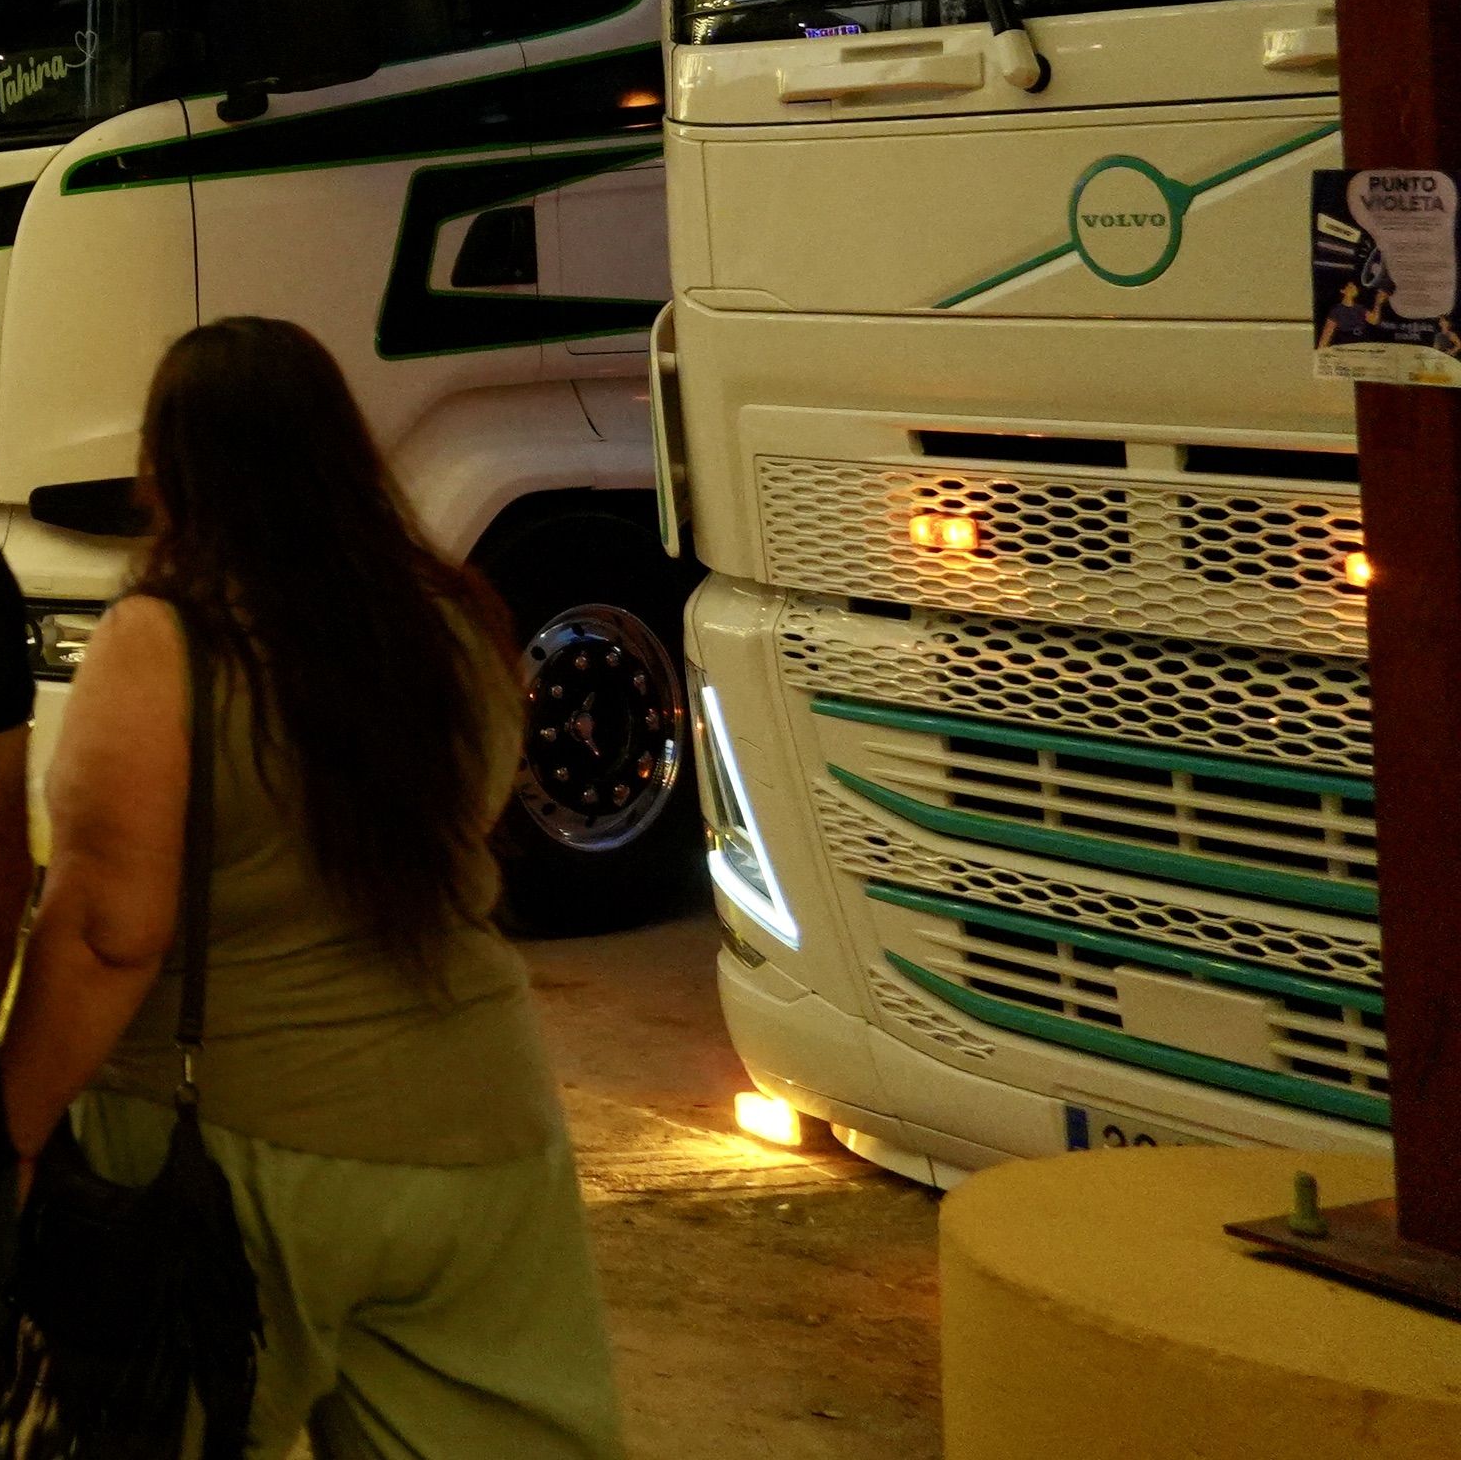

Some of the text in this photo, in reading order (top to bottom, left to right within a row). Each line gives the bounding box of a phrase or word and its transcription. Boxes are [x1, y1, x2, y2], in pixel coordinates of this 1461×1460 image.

[1369, 176, 1436, 191] PUNTO
[1361, 195, 1445, 212] VIOLETA
[1082, 213, 1166, 227] VOLVO
